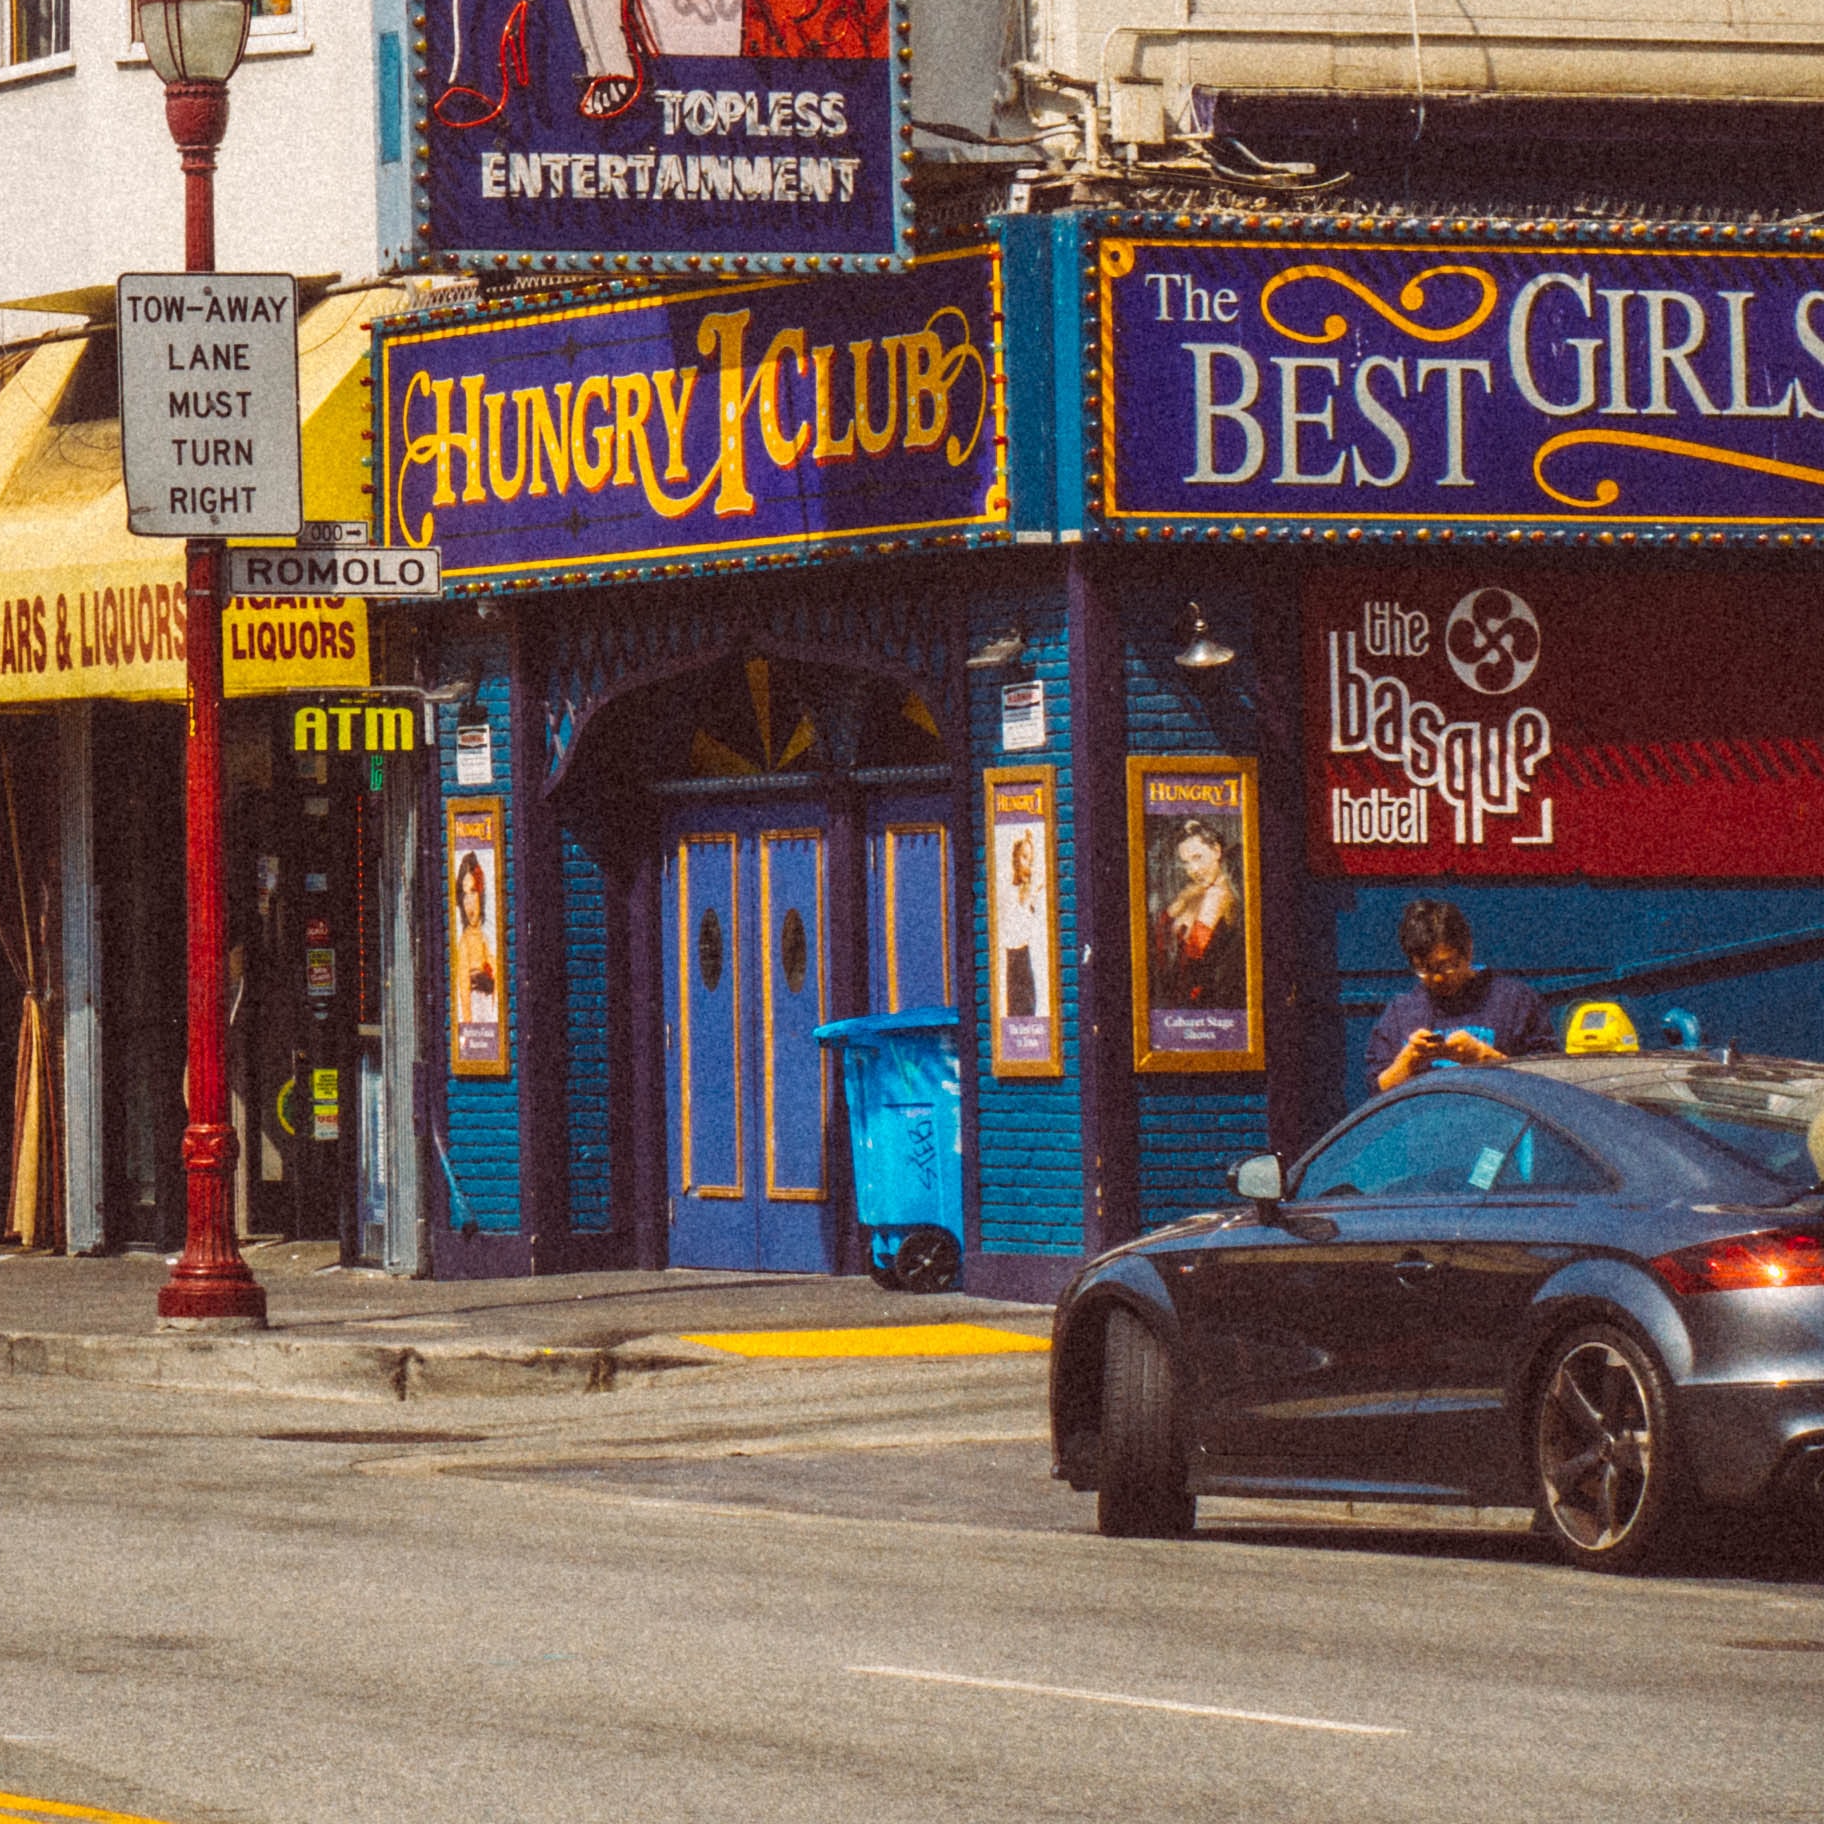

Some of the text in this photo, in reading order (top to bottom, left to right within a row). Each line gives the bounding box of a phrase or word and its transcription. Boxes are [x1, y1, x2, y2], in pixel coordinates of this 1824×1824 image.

[660, 90, 849, 138] TOPLESS
[481, 150, 861, 204] ENTERTAINMENT
[126, 294, 289, 324] TOW-AWAY
[1145, 273, 1239, 323] The
[168, 344, 252, 372] LANE
[169, 390, 253, 419] MUST
[398, 368, 712, 548] HUNGRY
[754, 305, 988, 468] CLUB
[1181, 341, 1492, 488] BEST
[171, 439, 254, 468] TURN
[170, 487, 257, 516] RIGHT
[247, 557, 425, 586] ROMOLO
[55, 620, 73, 673] &
[79, 580, 188, 672] LIQUORS
[231, 621, 356, 662] LIQUORS
[1364, 600, 1430, 657] the
[294, 706, 414, 751] ATM
[1328, 630, 1551, 844] basque
[1149, 782, 1226, 806] HUNGRY
[1332, 787, 1429, 844] hotel
